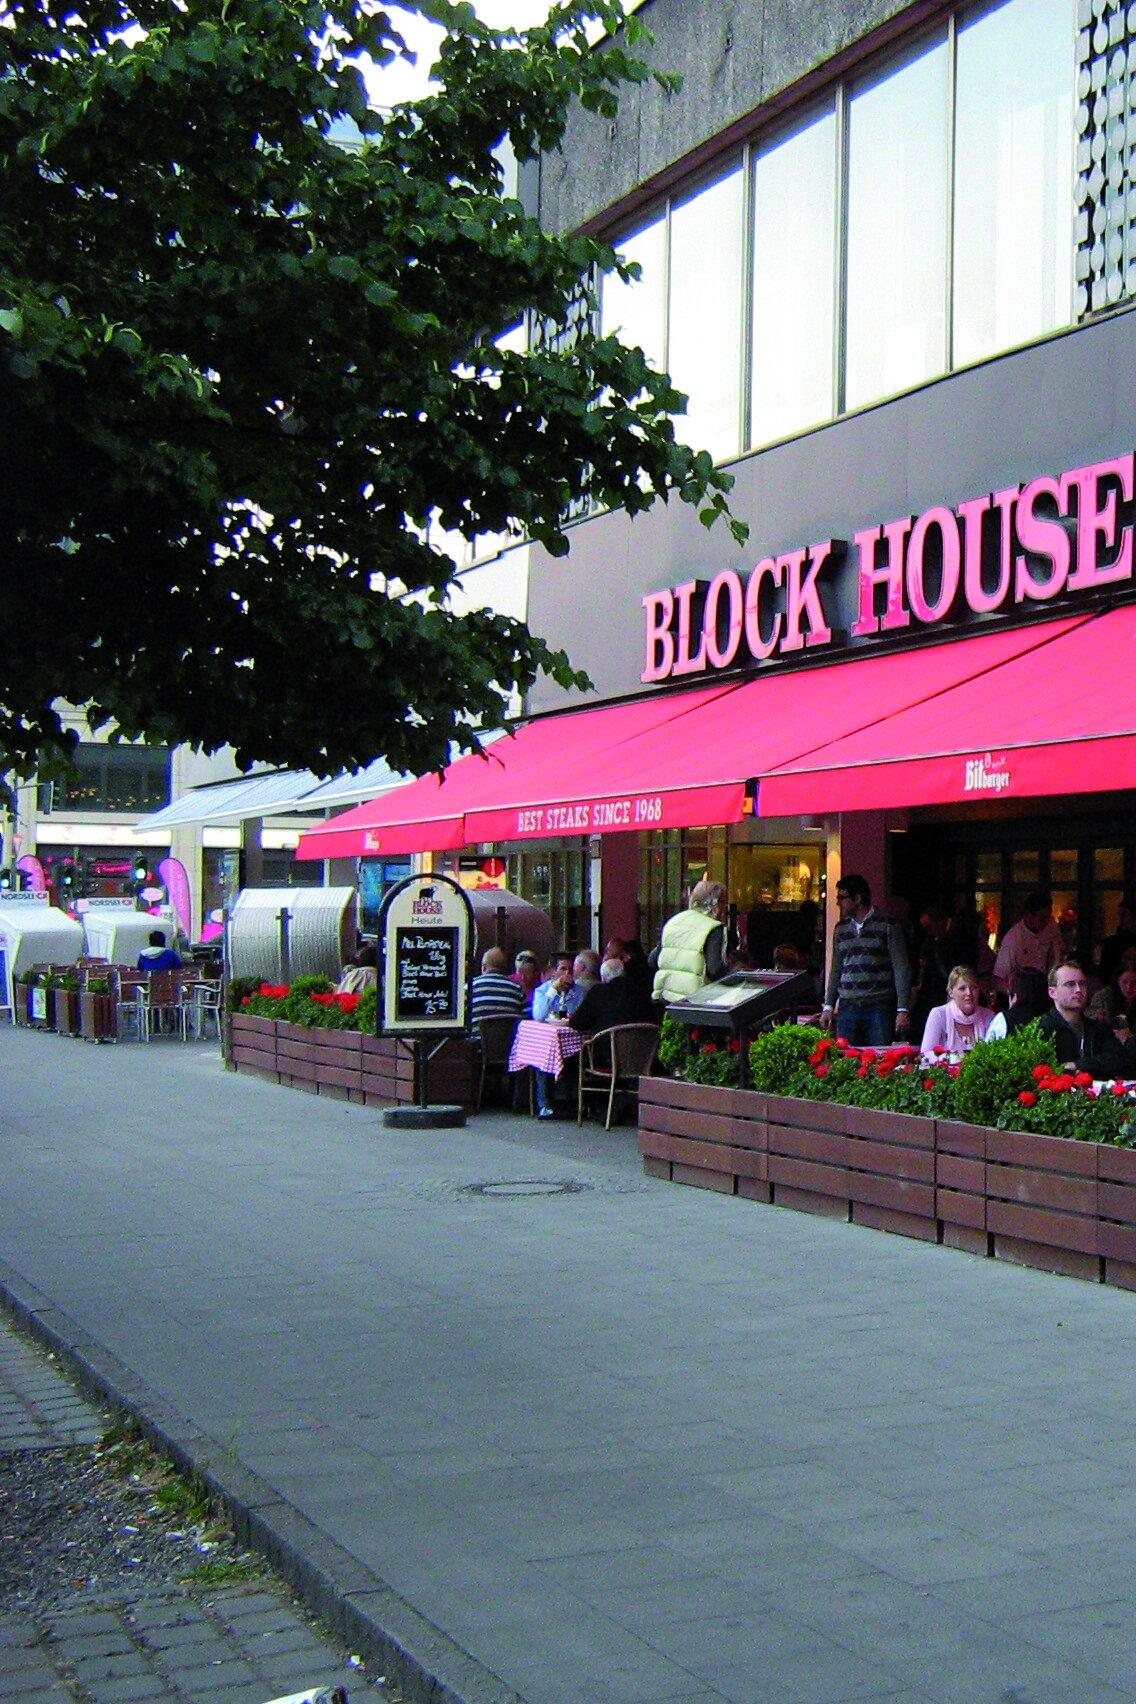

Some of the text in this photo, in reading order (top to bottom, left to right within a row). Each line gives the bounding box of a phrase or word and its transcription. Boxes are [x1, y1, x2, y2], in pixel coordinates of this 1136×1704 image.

[639, 539, 838, 683] BLOCK
[965, 760, 1010, 792] Bitburger
[517, 797, 662, 832] BEST STEAKS SINCE 1968
